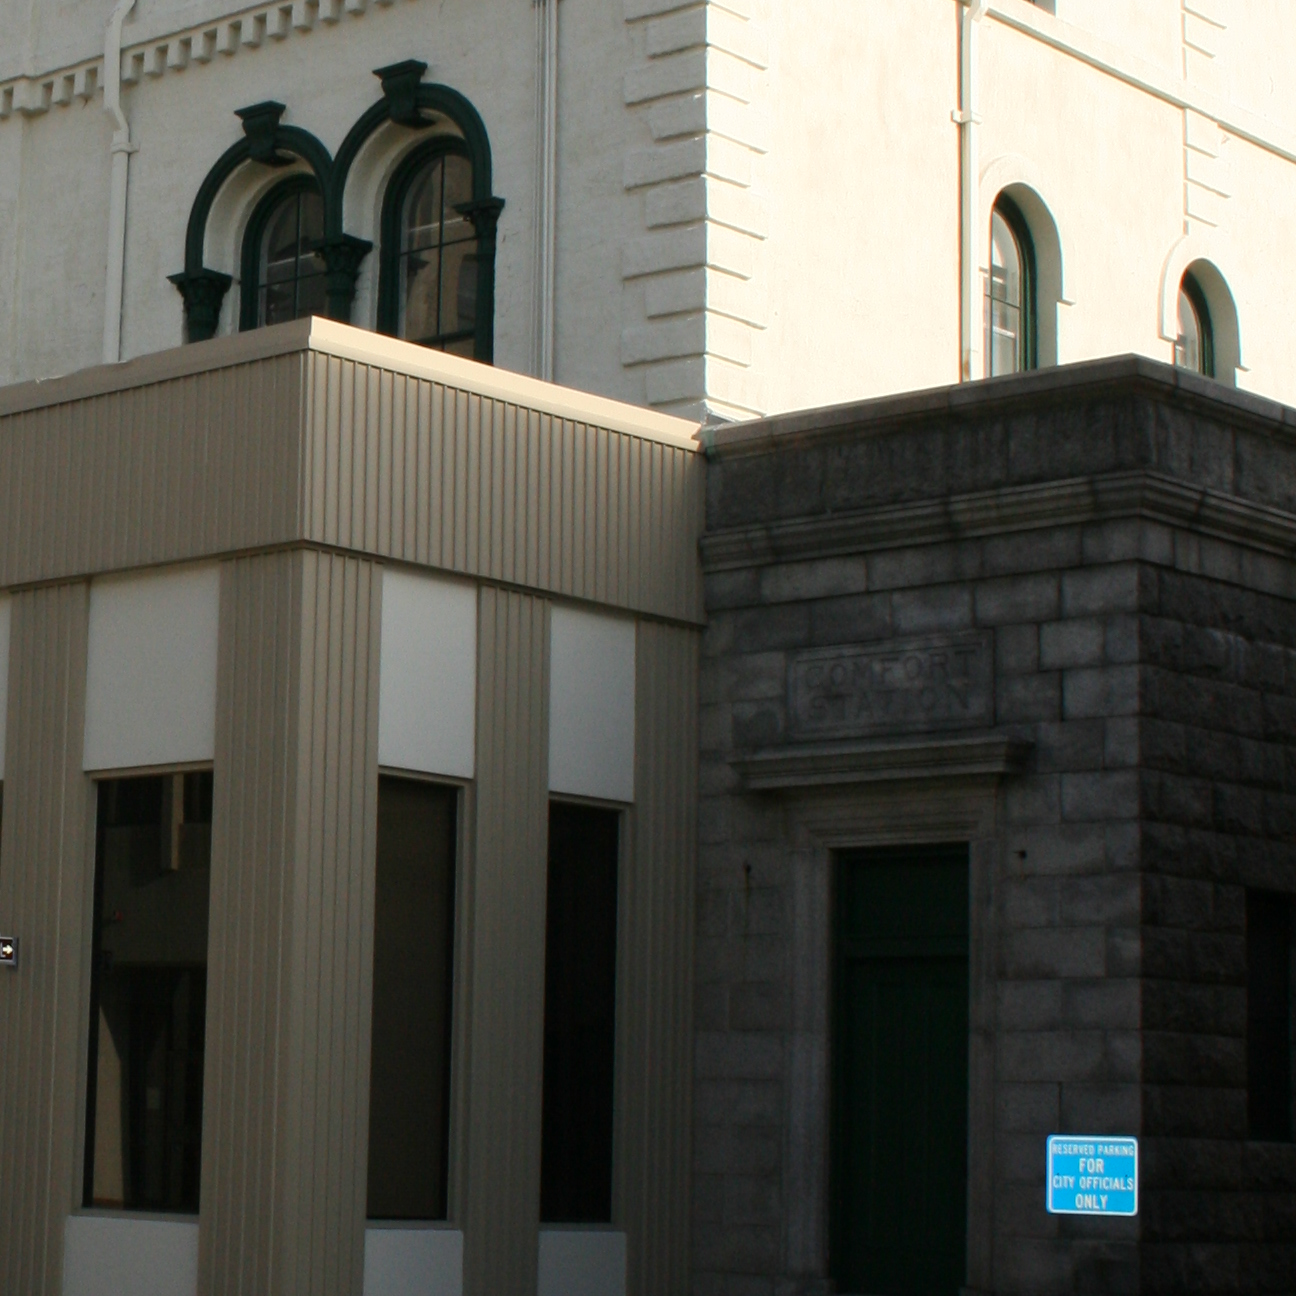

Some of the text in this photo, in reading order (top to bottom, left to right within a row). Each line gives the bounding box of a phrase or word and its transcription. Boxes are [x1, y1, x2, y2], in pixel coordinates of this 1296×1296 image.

[806, 648, 976, 689] COMFORT
[808, 683, 972, 720] STATION
[1052, 1143, 1134, 1156] RESERVED PARKING
[1079, 1158, 1104, 1174] FOR
[1053, 1175, 1134, 1191] CITY OFFICIALS
[1075, 1193, 1108, 1209] ONLY
